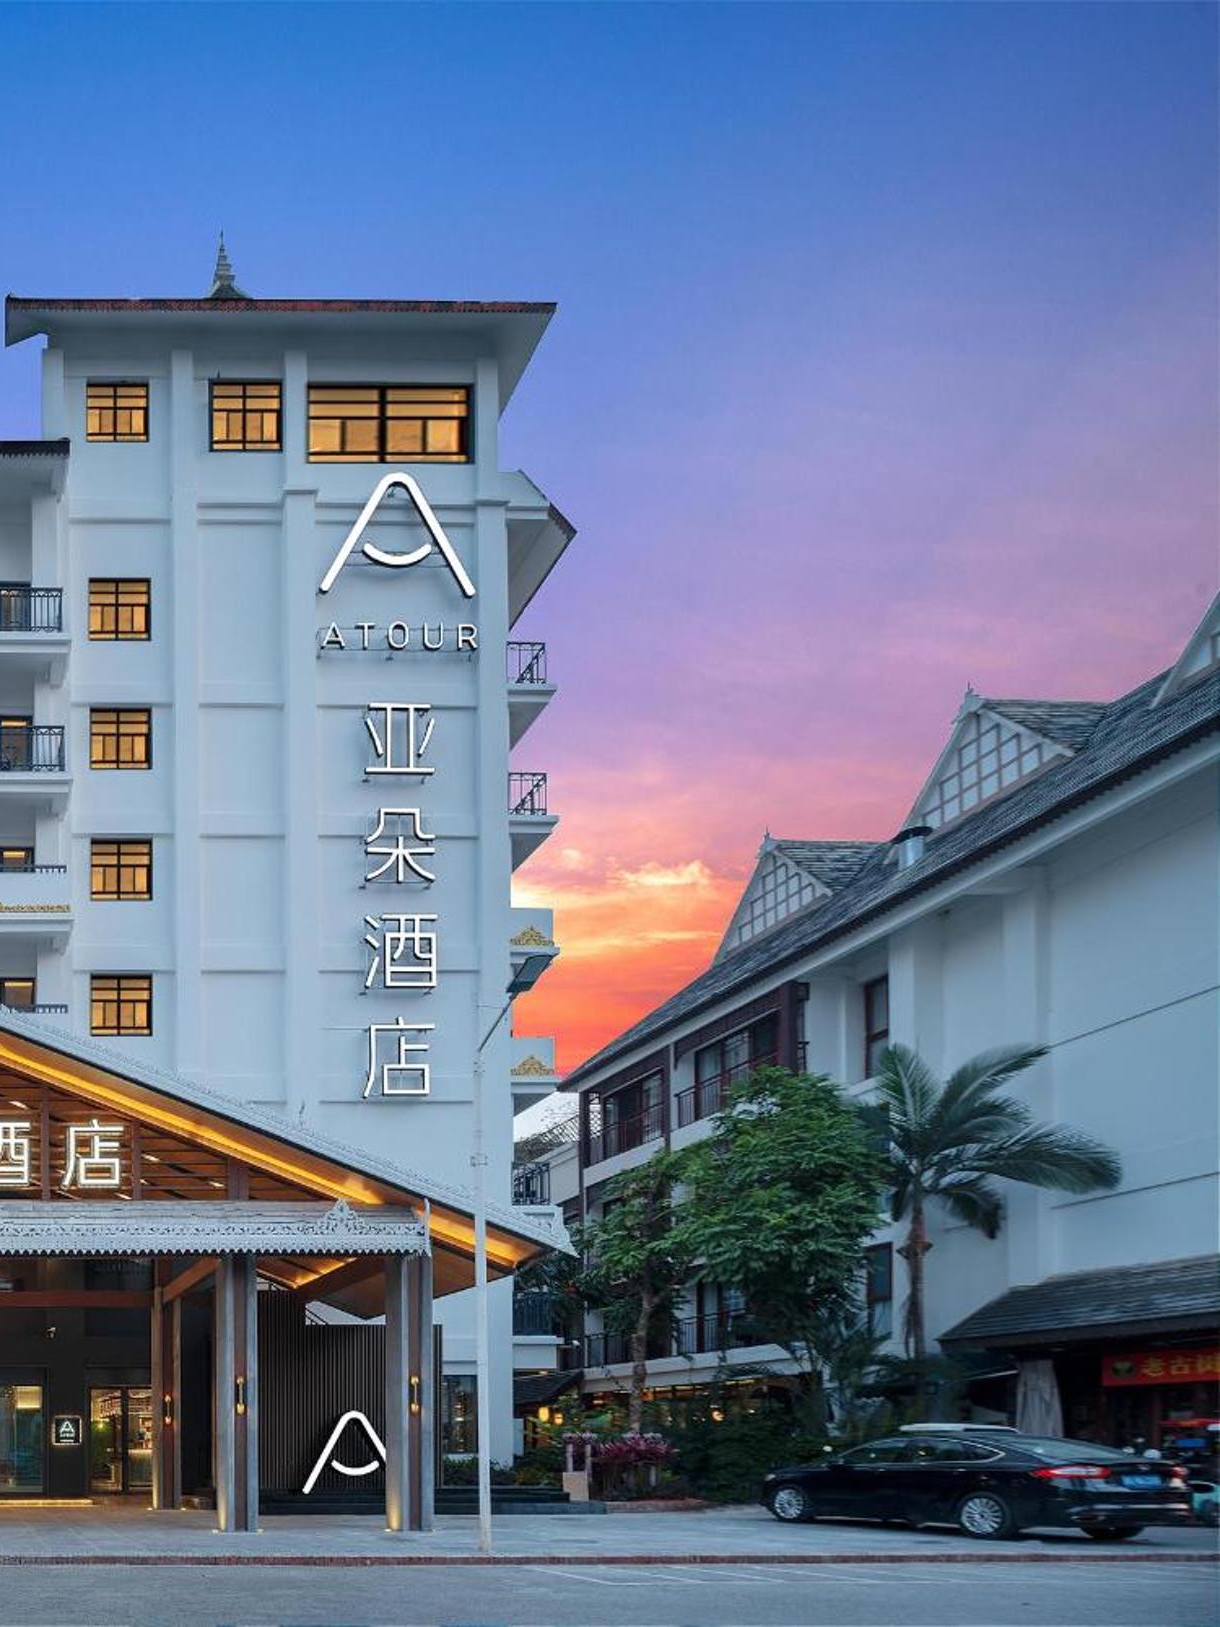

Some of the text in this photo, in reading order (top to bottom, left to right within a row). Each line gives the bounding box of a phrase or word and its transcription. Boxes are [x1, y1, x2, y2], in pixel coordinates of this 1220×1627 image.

[321, 620, 478, 650] ATOUR
[364, 702, 438, 1099] 亚朵酒店
